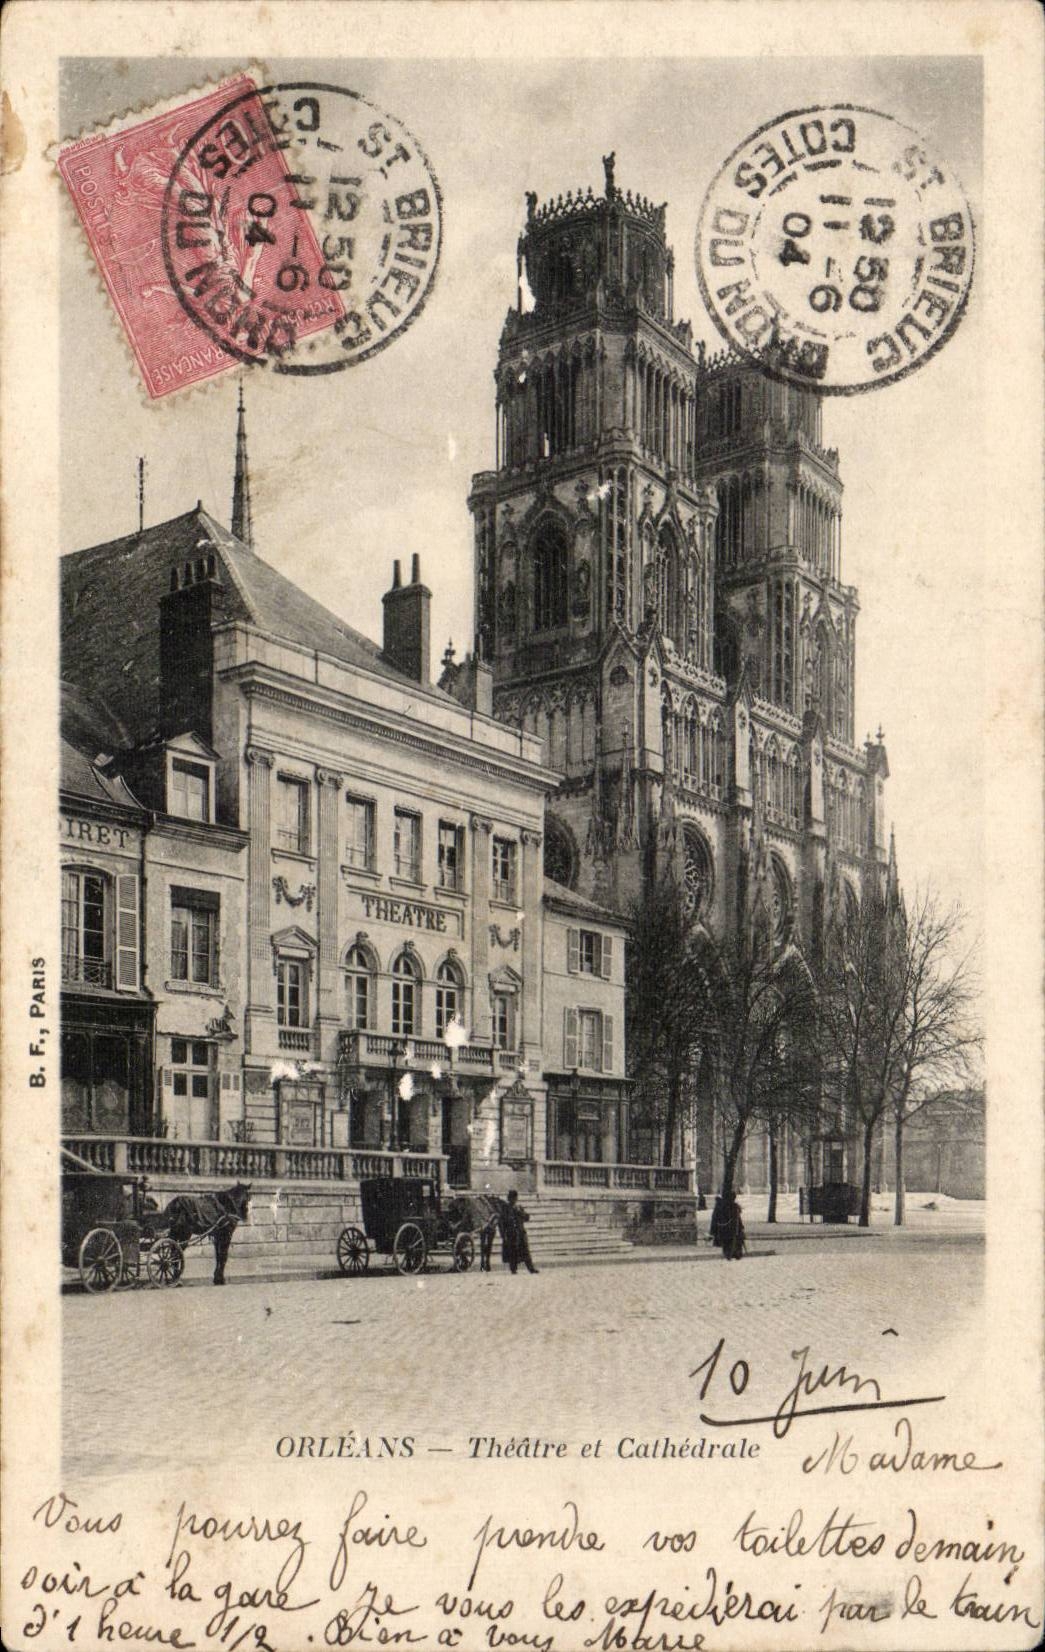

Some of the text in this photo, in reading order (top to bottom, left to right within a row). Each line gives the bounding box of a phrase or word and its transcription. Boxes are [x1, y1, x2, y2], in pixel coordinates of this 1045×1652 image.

[246, 192, 277, 247] 04
[710, 208, 750, 266] DU
[779, 213, 811, 266] 04
[335, 188, 432, 351] BRIEUC
[867, 212, 966, 373] BRIEUC
[151, 338, 230, 385] RANÇAISE
[59, 817, 130, 849] IRET
[361, 895, 447, 933] THEATRE
[689, 1338, 750, 1399] 10
[803, 1417, 1003, 1475] Madame
[33, 1492, 123, 1534] Vous
[165, 1501, 311, 1592] pourrez
[329, 1490, 427, 1591] faire
[468, 1501, 605, 1591] prendre
[642, 1528, 697, 1552] vos
[734, 1507, 886, 1559] toilettes
[20, 1562, 110, 1599] soir
[165, 1550, 201, 1601] la
[206, 1585, 320, 1632] gare
[435, 1591, 514, 1618] vous
[819, 1587, 891, 1634] par
[902, 1575, 938, 1619] le
[950, 1573, 1040, 1628] train
[99, 1597, 197, 1648] heure
